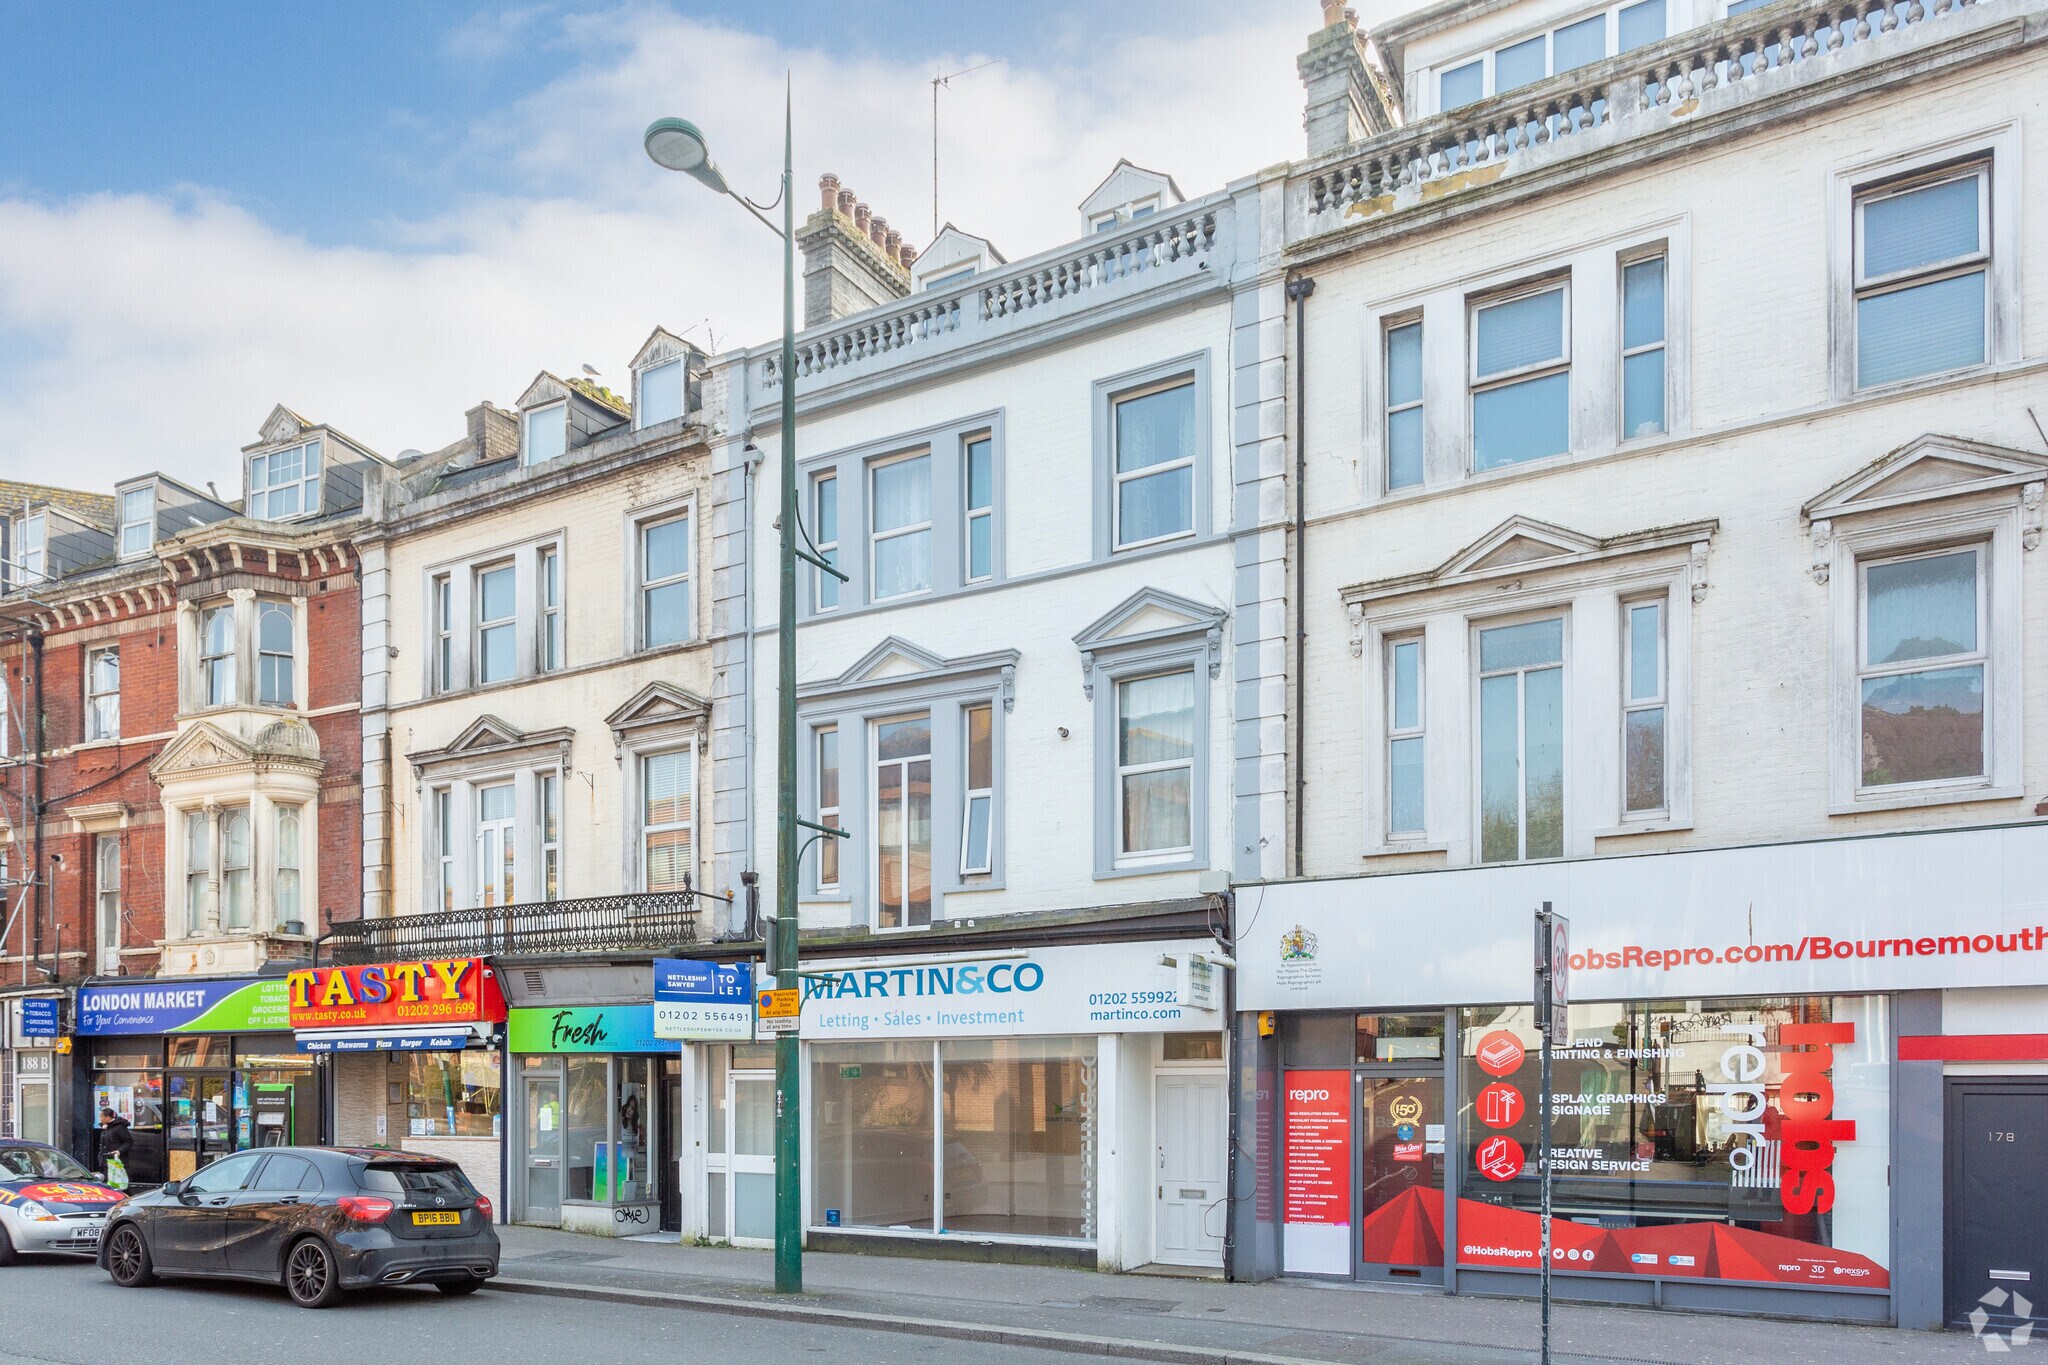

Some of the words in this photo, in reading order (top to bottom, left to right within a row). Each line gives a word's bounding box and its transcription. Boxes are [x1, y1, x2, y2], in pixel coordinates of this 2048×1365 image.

[1569, 926, 2048, 972] obsRepro.com/Bournemouth
[667, 974, 707, 982] NETTLESHIP
[718, 975, 735, 984] TO
[804, 963, 1044, 999] MARTIN&CO
[261, 984, 288, 992] LOTTER
[286, 961, 473, 1007] TASTY
[719, 986, 742, 996] LET
[83, 993, 141, 1011] LONDON
[144, 990, 206, 1009] MARKET
[260, 995, 288, 1003] TOBACC
[1089, 993, 1127, 1005] 01202
[292, 1008, 366, 1022] www.tasty.co.uk
[397, 1005, 429, 1017] 01202
[433, 1004, 452, 1015] 296
[455, 1003, 476, 1014] 699
[659, 1010, 698, 1020] 01202
[704, 1011, 749, 1021] 556491
[1090, 1008, 1180, 1020] martinco.com
[83, 1015, 93, 1026] For
[95, 1014, 111, 1031] Your
[114, 1013, 154, 1026] Convenience
[264, 1016, 288, 1024] LICENC
[819, 1014, 869, 1031] Letting
[884, 1011, 921, 1025] Sales
[937, 1008, 1025, 1024] Investment
[551, 1010, 608, 1049] Fresh
[307, 1041, 331, 1049] Chicken
[337, 1041, 368, 1049] Shawarma
[376, 1040, 392, 1048] Pizza
[400, 1039, 422, 1048] Burger
[430, 1038, 453, 1047] Kebab
[1604, 1050, 1613, 1059] &
[1616, 1049, 1685, 1059] FINISHING
[22, 1057, 39, 1070] 188
[41, 1057, 48, 1069] B
[1289, 1089, 1329, 1104] repro
[1539, 1094, 1592, 1104] SPLAY
[1597, 1094, 1666, 1104] GRAPHICS
[1706, 1024, 1766, 1171] repro
[1552, 1106, 1611, 1115] SIGNAGE
[1779, 1022, 1856, 1215] hobs
[1988, 1132, 2015, 1142] 178
[1539, 1149, 1603, 1158] REATIVE
[1591, 1161, 1650, 1171] SERVICE
[418, 1213, 437, 1223] BP16
[439, 1213, 455, 1222] BBU
[77, 1228, 100, 1237] WF08
[1464, 1245, 1532, 1258] @HobsRepro
[1779, 1264, 1801, 1272] repro
[1811, 1265, 1825, 1273] 3D
